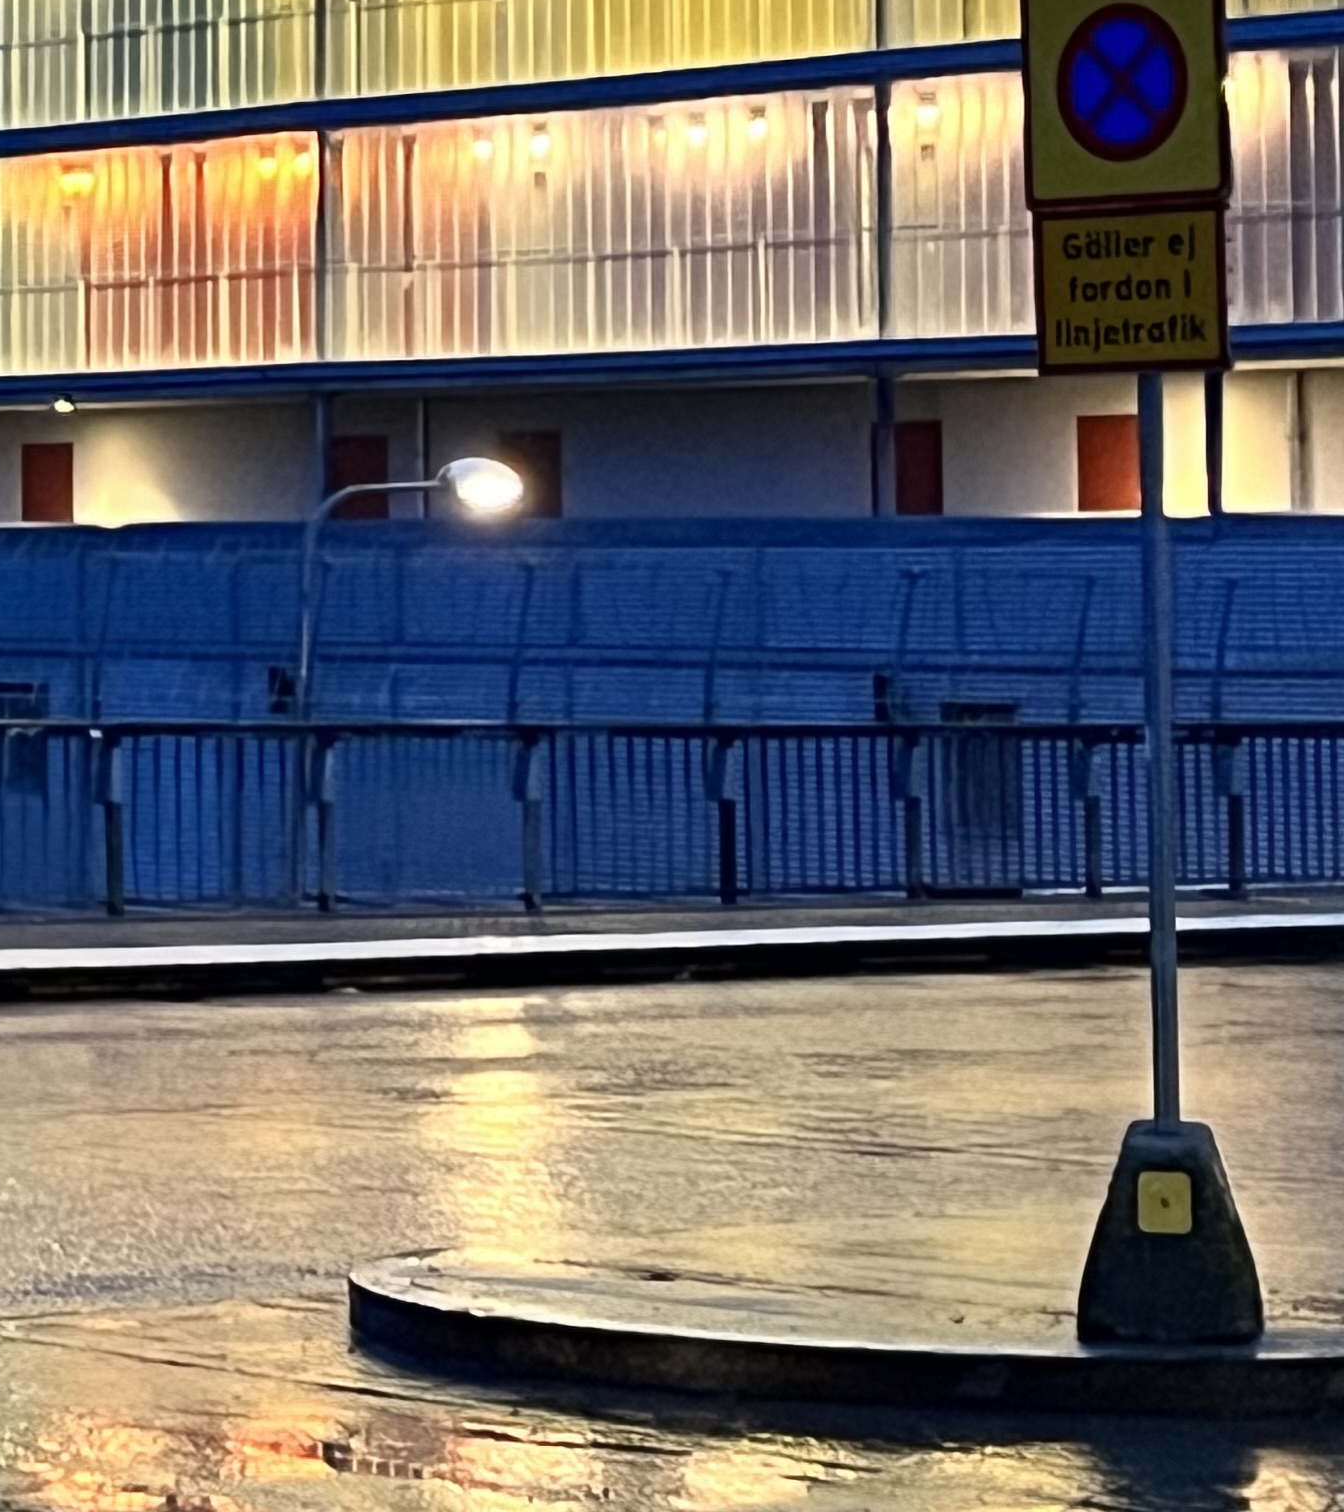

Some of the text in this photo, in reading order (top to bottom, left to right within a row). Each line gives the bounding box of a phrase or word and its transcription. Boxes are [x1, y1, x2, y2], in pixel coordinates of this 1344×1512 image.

[1062, 223, 1196, 261] Gäller ej
[1069, 272, 1172, 303] fordon
[1055, 313, 1207, 353] linjetrafik
